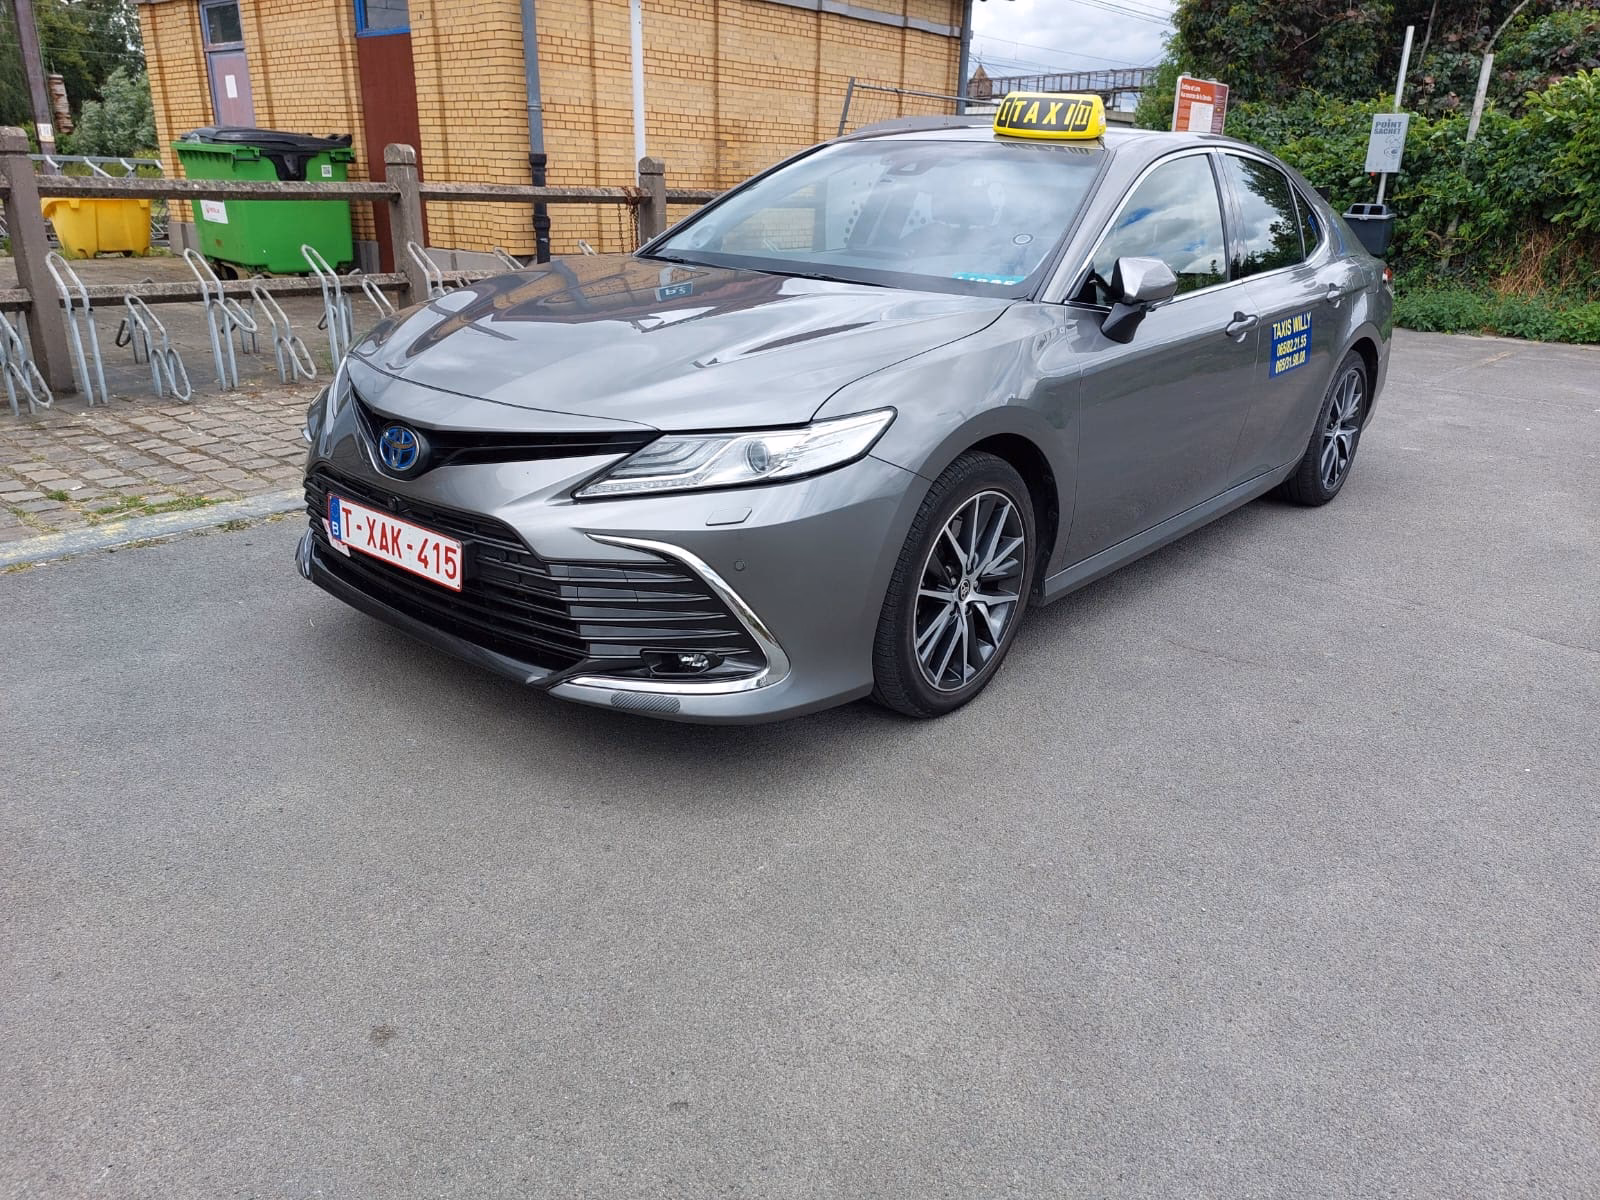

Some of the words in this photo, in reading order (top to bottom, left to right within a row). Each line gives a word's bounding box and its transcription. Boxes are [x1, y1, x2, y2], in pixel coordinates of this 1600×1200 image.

[1012, 100, 1076, 125] TAXI
[1375, 120, 1402, 128] POINT
[1272, 318, 1292, 340] TAXIS
[1293, 311, 1312, 333] WILLY
[332, 521, 339, 536] B
[341, 507, 457, 580] T-XAK-415
